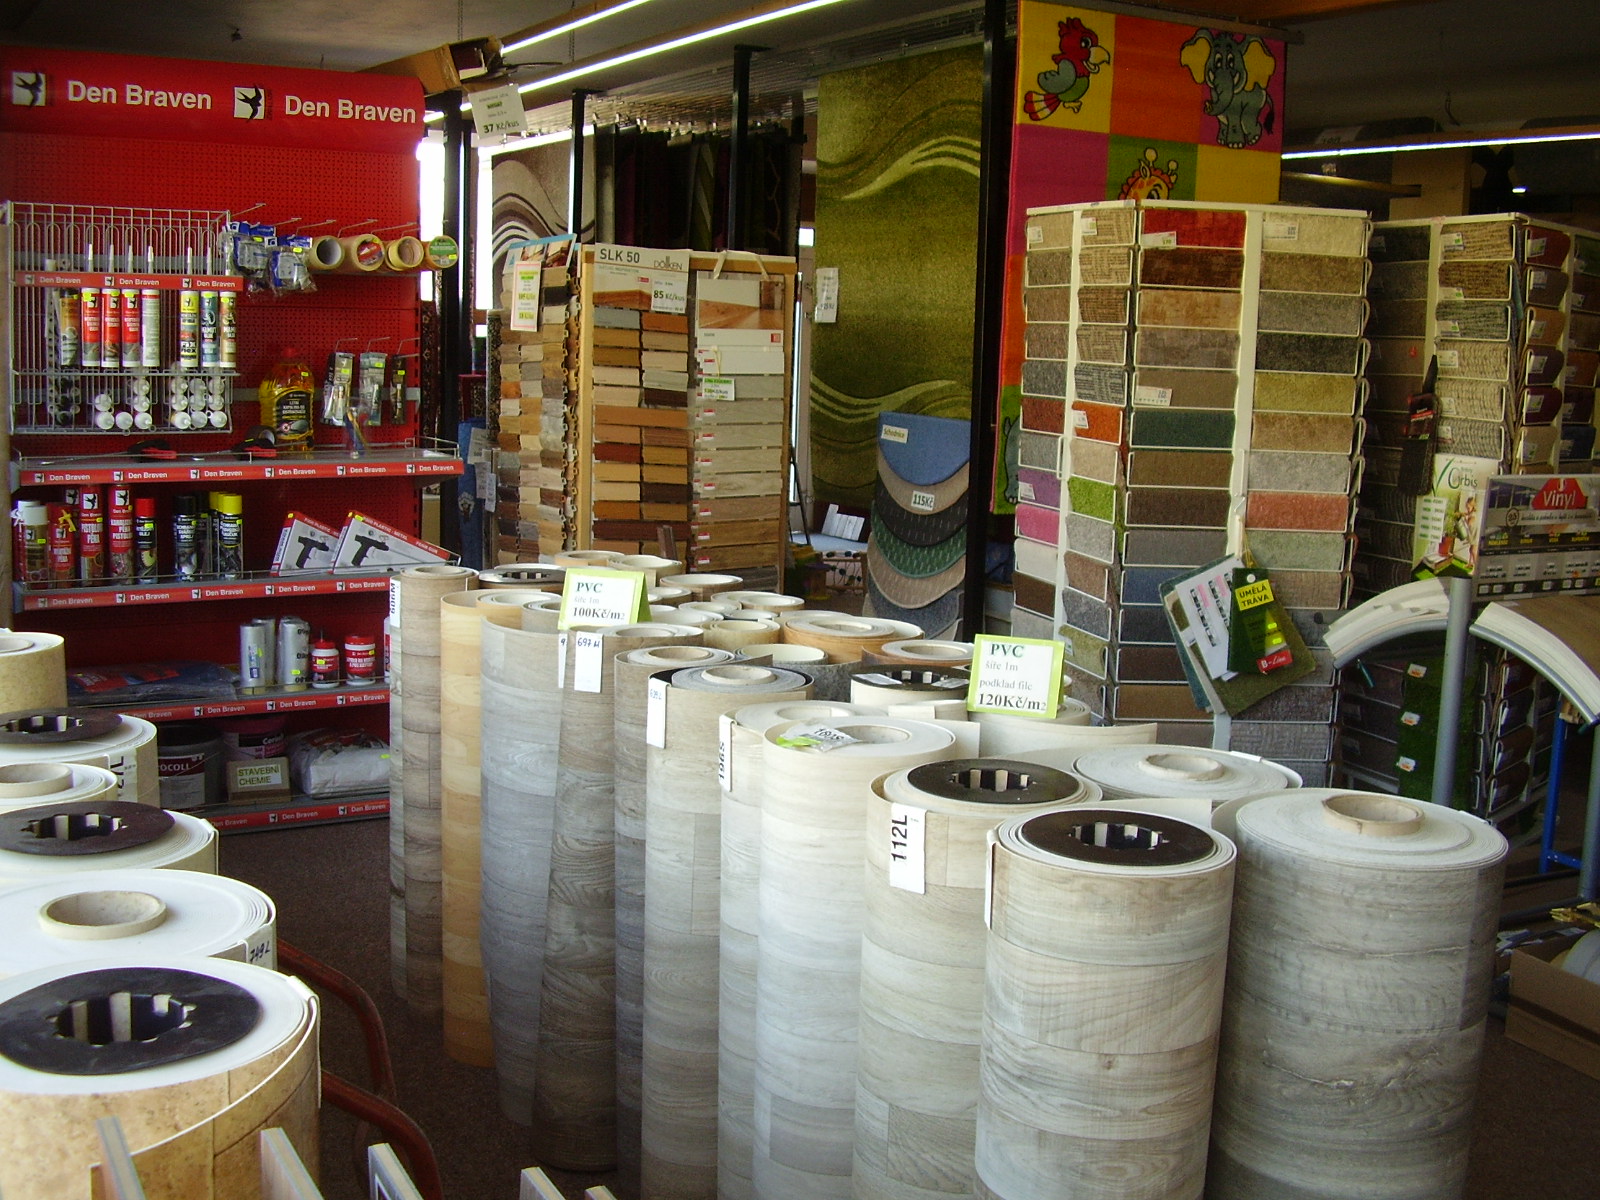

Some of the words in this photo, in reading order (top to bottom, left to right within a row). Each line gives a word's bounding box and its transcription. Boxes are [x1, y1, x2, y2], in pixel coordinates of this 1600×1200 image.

[67, 80, 117, 103] Den
[125, 84, 212, 110] Braven
[285, 95, 330, 118] Den
[338, 99, 416, 124] Braven
[483, 124, 493, 133] 37
[600, 248, 623, 262] SLK
[626, 251, 640, 264] 50
[56, 277, 81, 285] Braven
[119, 278, 133, 286] Den
[135, 278, 160, 287] Braven
[197, 280, 210, 288] Den
[211, 280, 236, 288] Braven
[653, 290, 664, 299] 85
[278, 468, 291, 476] Den
[293, 467, 316, 475] Braven
[365, 466, 387, 474] Braven
[434, 464, 454, 472] Braven
[50, 474, 64, 482] Den
[65, 473, 91, 481] Braven
[143, 471, 168, 479] Braven
[219, 469, 243, 477] Braven
[913, 494, 935, 508] 115Kč
[1543, 489, 1576, 510] Vinyl
[278, 585, 291, 593] Den
[293, 584, 316, 592] Braven
[350, 582, 363, 590] Den
[365, 581, 386, 589] Braven
[576, 581, 603, 593] PVC
[145, 592, 170, 600] Braven
[205, 589, 218, 597] Den
[219, 588, 244, 597] Braven
[1239, 585, 1267, 599] UMĚLÁ
[1241, 594, 1270, 608] TRÁVA
[990, 643, 1025, 658] PVC
[1005, 662, 1019, 671] 1m
[979, 679, 1015, 689] podklad
[1018, 680, 1033, 691] filc
[350, 695, 362, 703] Den
[363, 694, 385, 702] Braven
[280, 700, 293, 708] Den
[294, 699, 317, 707] Braven
[208, 706, 220, 714] Den
[222, 704, 245, 712] Braven
[238, 763, 280, 777] STAVEBNÍ
[239, 776, 272, 786] CHEMIE
[351, 805, 363, 813] Den
[365, 803, 386, 811] Braven
[282, 812, 295, 820] Den
[297, 811, 318, 819] Braven
[891, 814, 908, 862] 112L
